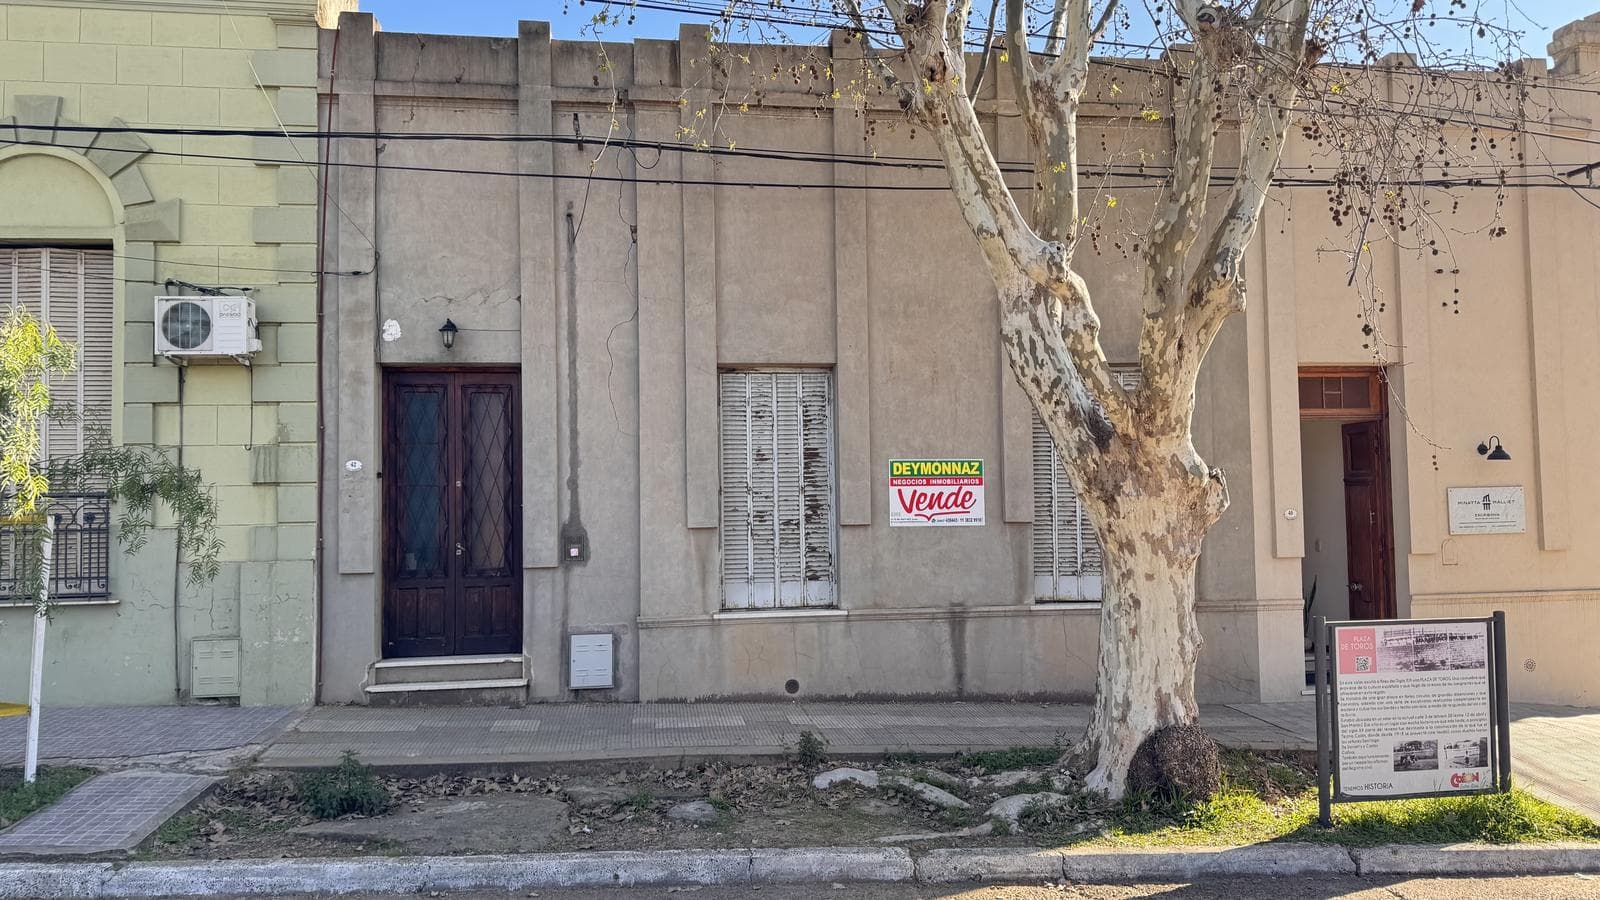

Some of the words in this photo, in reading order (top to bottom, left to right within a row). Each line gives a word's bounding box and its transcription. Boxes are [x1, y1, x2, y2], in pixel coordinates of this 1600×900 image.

[893, 462, 980, 475] DEYMONNAZ
[897, 485, 977, 514] Vende
[1350, 642, 1374, 650] TOROS
[1364, 782, 1393, 791] HISTORIA
